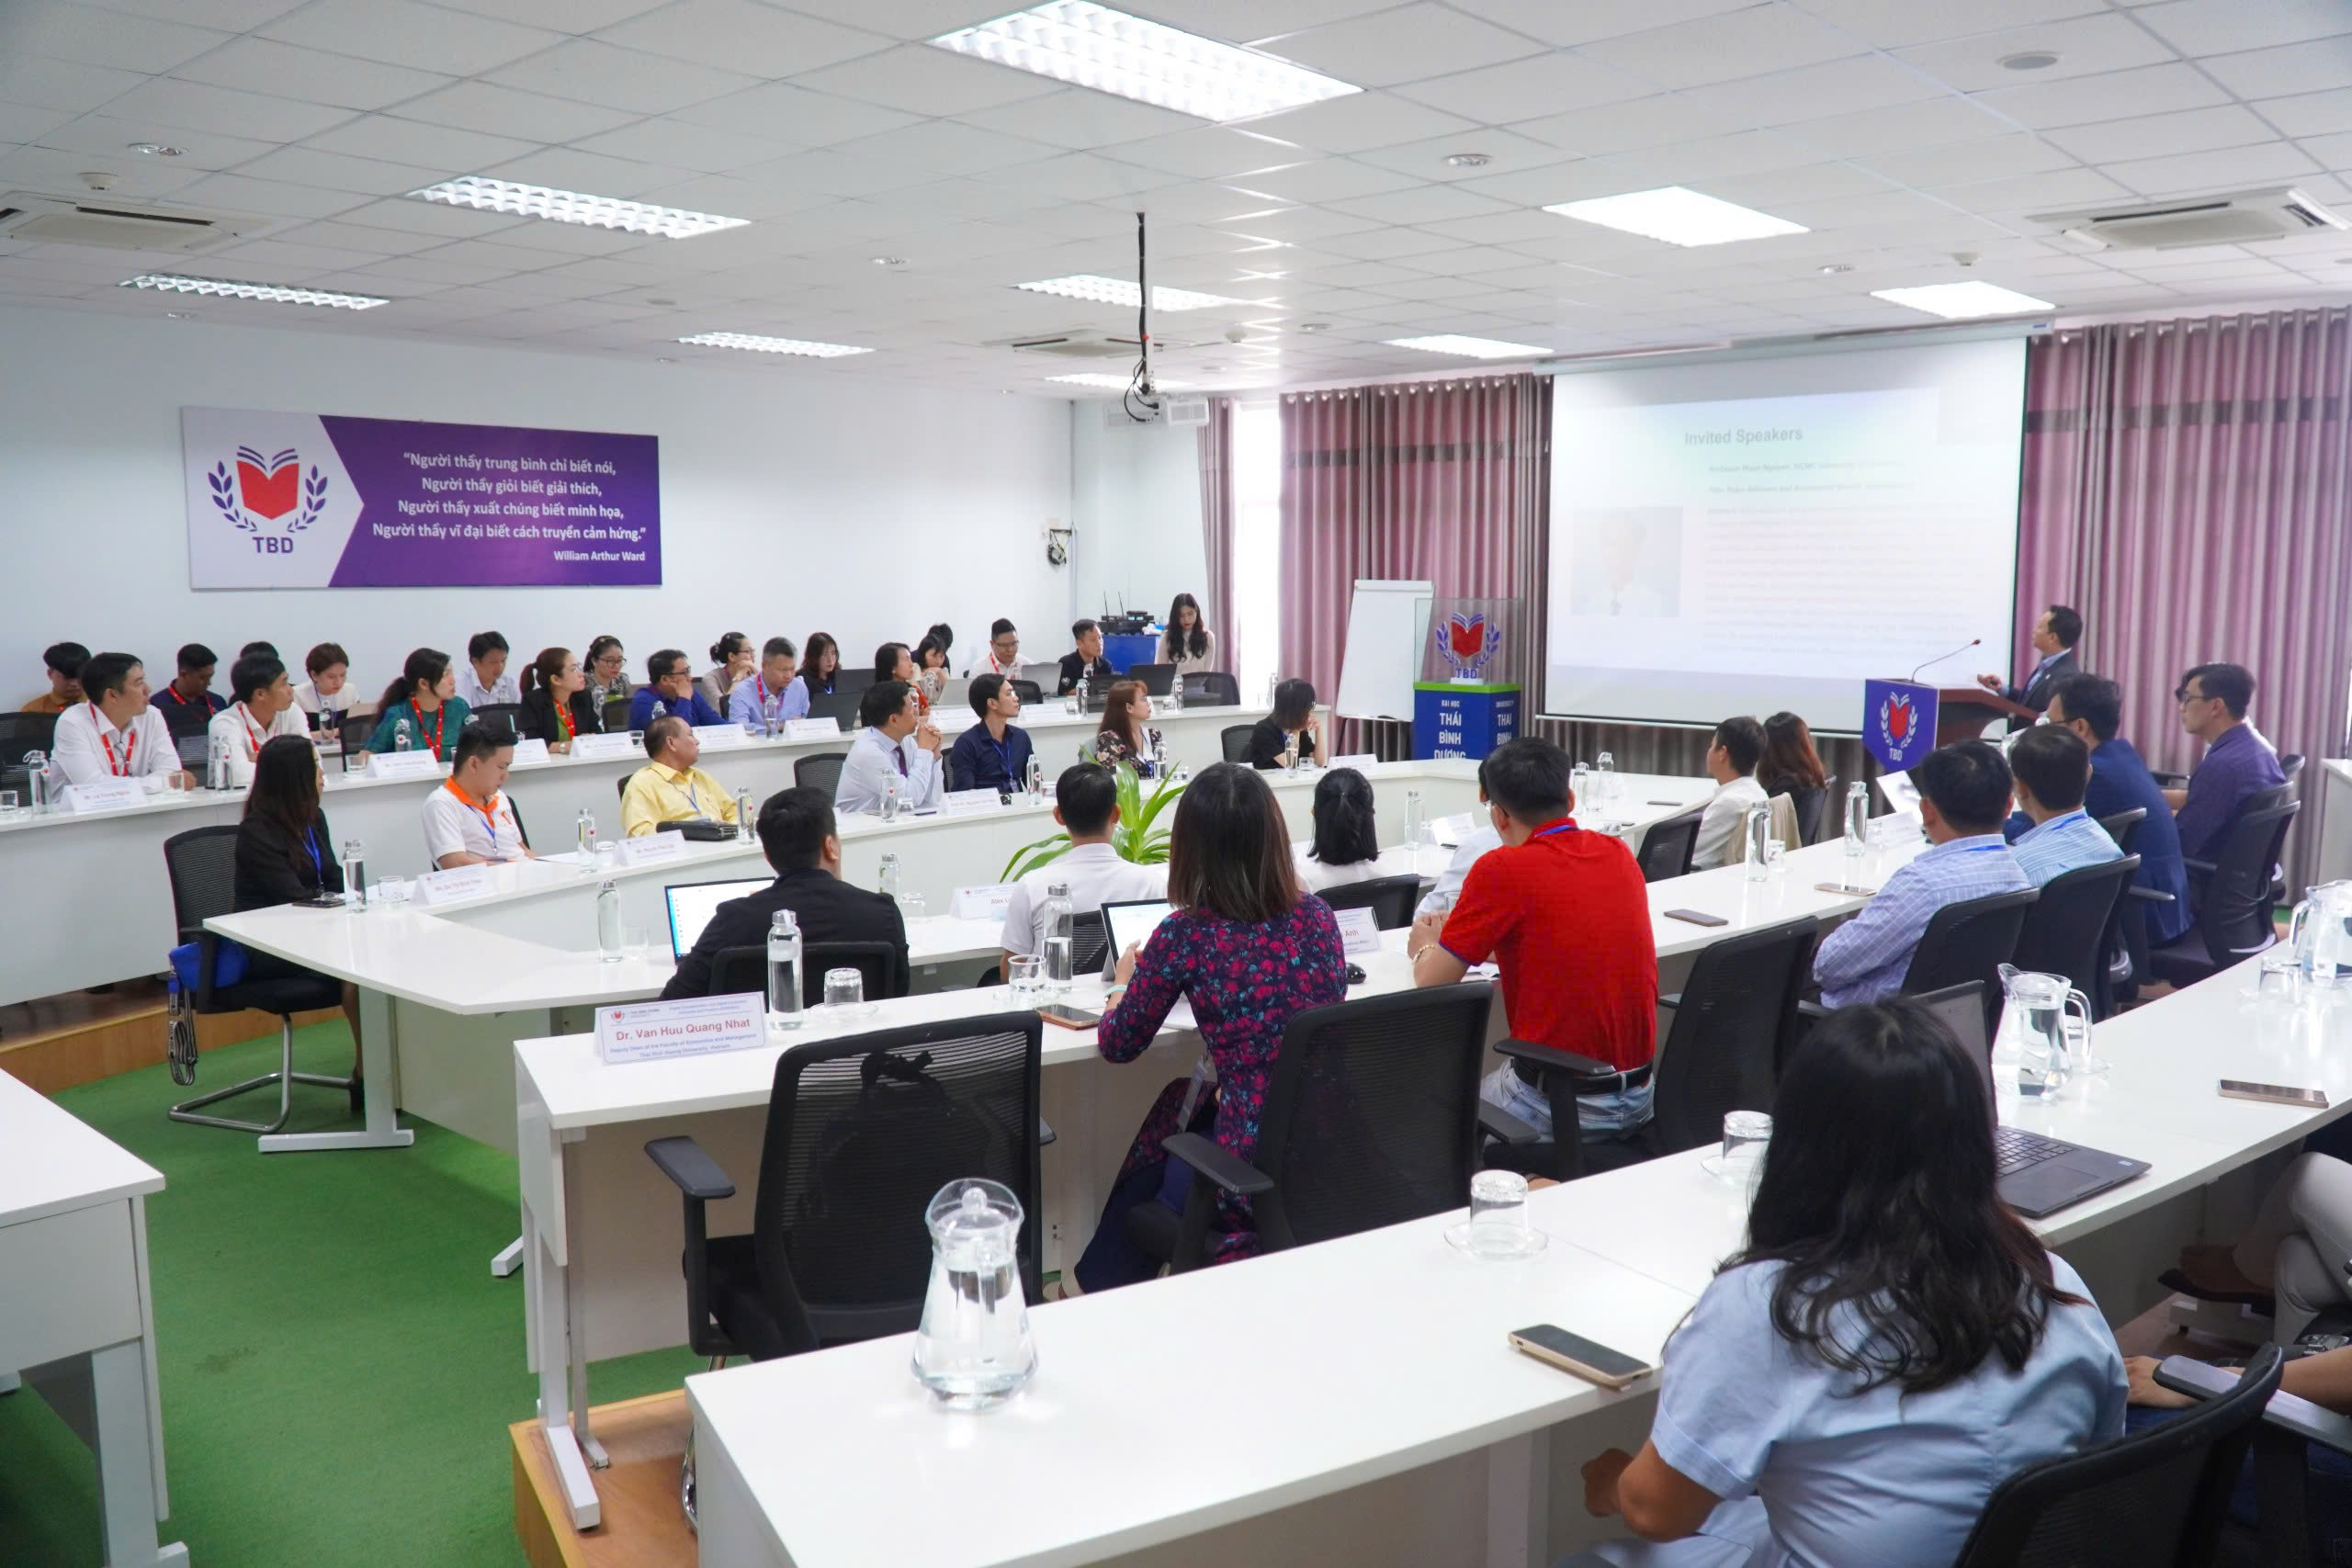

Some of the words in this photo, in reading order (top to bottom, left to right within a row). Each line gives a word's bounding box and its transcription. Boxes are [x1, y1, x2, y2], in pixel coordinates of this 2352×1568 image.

[1684, 429, 1732, 446] Invited
[1736, 427, 1804, 446] Speakers
[454, 454, 482, 471] thầy
[484, 457, 519, 472] trung
[521, 457, 547, 471] bình
[570, 458, 593, 473] biết
[594, 460, 616, 476] nói,
[422, 477, 463, 493] Người
[465, 477, 493, 494] thầy
[495, 478, 518, 494] giỏi
[521, 479, 544, 493] biết
[547, 479, 568, 496] giải
[570, 481, 603, 497] thích,
[398, 499, 439, 515] Người
[442, 500, 470, 517] thầy
[473, 500, 501, 515] xuất
[503, 502, 540, 518] chúng
[542, 502, 566, 516] biết
[568, 503, 597, 516] minh
[599, 504, 625, 520] họa,
[372, 522, 415, 539] Người
[418, 523, 447, 540] thầy
[449, 524, 462, 537] vĩ
[463, 524, 483, 540] đại
[486, 524, 511, 538] biết
[513, 525, 540, 538] cách
[542, 524, 582, 541] truyền
[582, 525, 606, 539] cảm
[252, 536, 294, 554] TBD
[553, 550, 589, 561] William
[591, 550, 620, 561] Arthur
[622, 550, 646, 561] Ward
[1455, 668, 1477, 679] TBD
[1440, 711, 1462, 727] THÁI
[1498, 713, 1512, 727] THAI
[1439, 728, 1462, 745] BÌNH
[1345, 929, 1360, 937] Anh
[616, 1030, 633, 1041] Dr.
[636, 1028, 658, 1039] Van
[661, 1026, 684, 1037] Huu
[685, 1023, 722, 1032] Quang
[725, 1019, 751, 1029] Nhat
